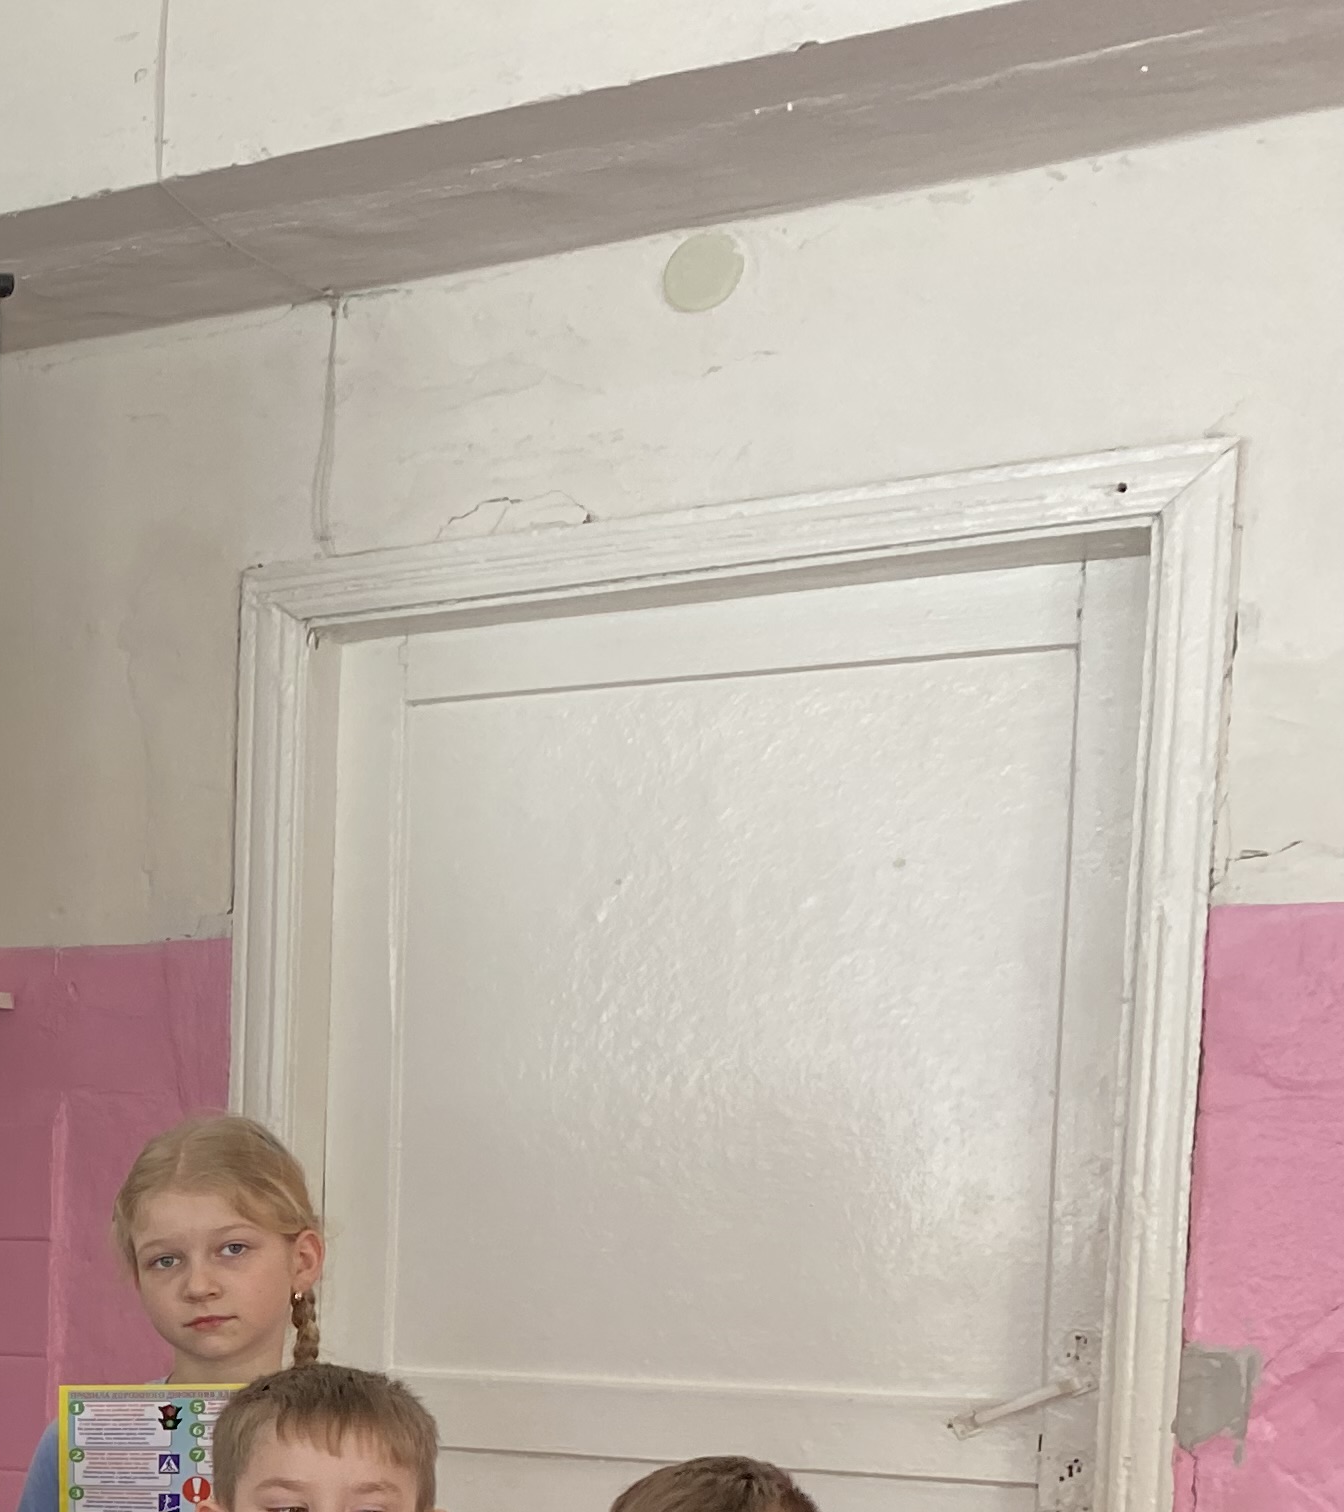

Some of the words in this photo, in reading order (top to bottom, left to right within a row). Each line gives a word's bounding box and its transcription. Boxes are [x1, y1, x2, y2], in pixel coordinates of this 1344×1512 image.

[73, 1404, 80, 1413] 1
[193, 1403, 202, 1412] 5
[193, 1426, 202, 1435] 6
[73, 1451, 82, 1460] 2
[192, 1451, 202, 1460] 7
[73, 1489, 81, 1498] 3
